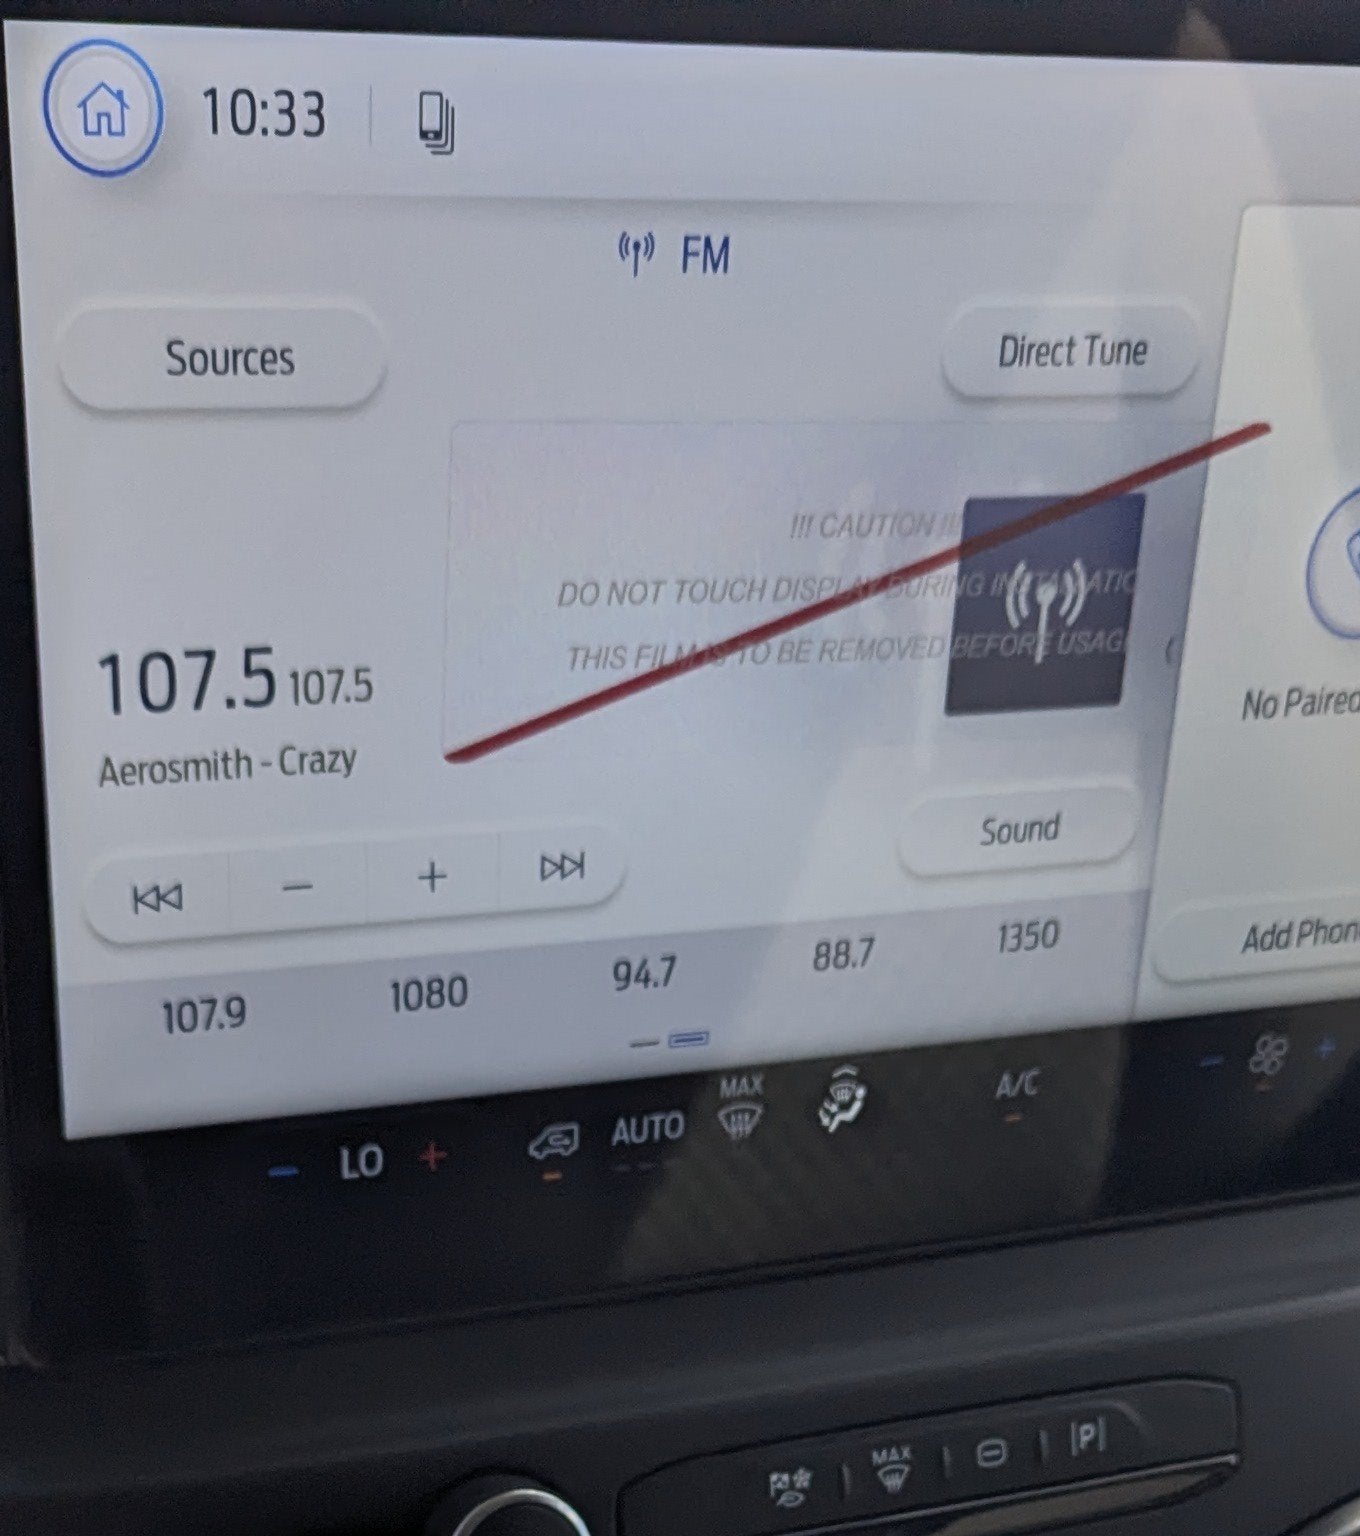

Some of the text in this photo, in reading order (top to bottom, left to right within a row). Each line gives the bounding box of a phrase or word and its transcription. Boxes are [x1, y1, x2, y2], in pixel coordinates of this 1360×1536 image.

[202, 86, 327, 138] 10:33
[680, 234, 731, 274] FM
[165, 338, 296, 378] Sources
[998, 333, 1149, 369] Direct Tune
[820, 510, 937, 539] CAUTION
[557, 580, 600, 607] DO
[606, 579, 666, 606] NOT
[676, 577, 767, 605] TOUCH
[568, 645, 628, 672] THIS
[777, 639, 815, 665] BE
[818, 632, 946, 664] REMOVED
[1057, 629, 1127, 656] USAG
[98, 645, 374, 716] 107.5 107.5
[1242, 688, 1278, 721] No
[99, 747, 254, 788] Aerosmith
[278, 744, 358, 780] Crazy
[980, 811, 1062, 847] Sound
[998, 917, 1061, 953] 1350
[1241, 921, 1292, 954] Add
[812, 935, 876, 972] 88.7
[612, 954, 678, 992] 94.7
[390, 974, 469, 1013] 1080
[162, 994, 247, 1035] 107.9
[719, 1074, 764, 1098] MAX
[995, 1067, 1040, 1099] A/C
[611, 1109, 686, 1147] AUTO
[340, 1144, 384, 1180] LO
[871, 1446, 912, 1466] MAX
